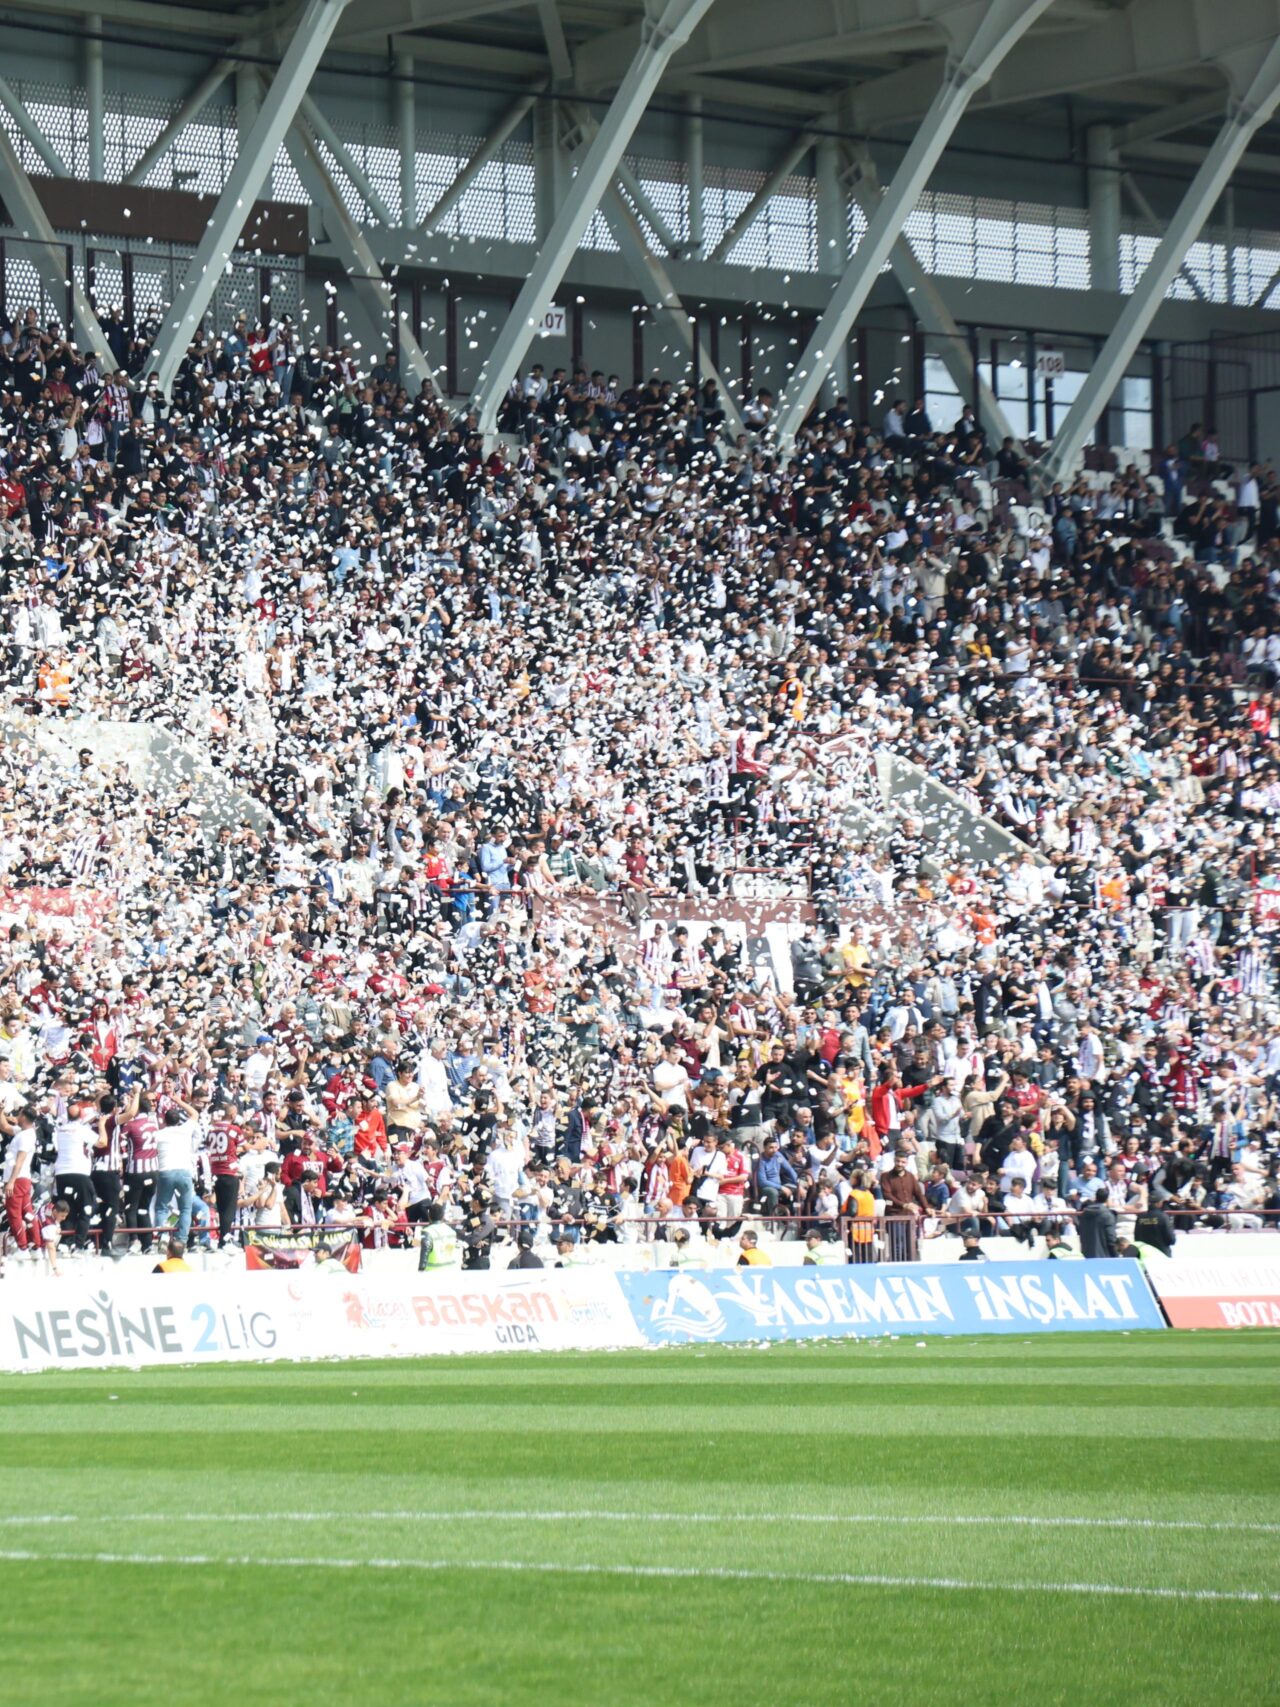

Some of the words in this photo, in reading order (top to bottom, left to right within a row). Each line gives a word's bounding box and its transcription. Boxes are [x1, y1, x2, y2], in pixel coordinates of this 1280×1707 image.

[723, 1274, 955, 1327] YASEMİN
[964, 1273, 1139, 1324] İNŞAAT
[495, 1324, 540, 1344] GIDA
